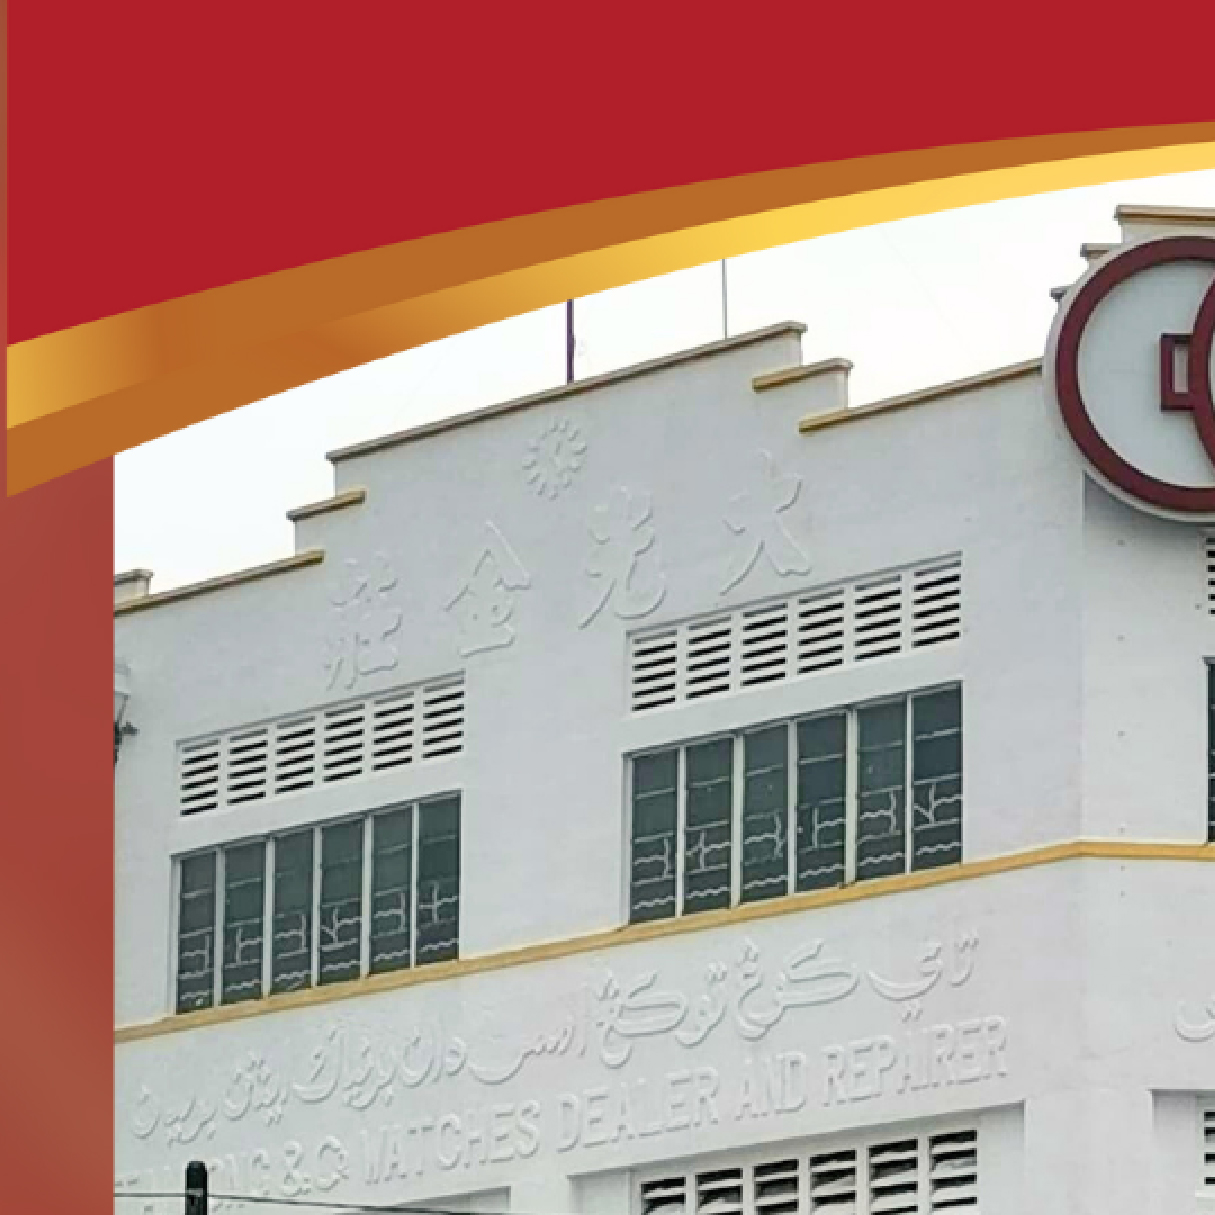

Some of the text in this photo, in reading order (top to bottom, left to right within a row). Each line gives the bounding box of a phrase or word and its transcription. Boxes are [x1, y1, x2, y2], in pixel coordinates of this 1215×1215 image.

[556, 1066, 720, 1153] DEALER
[735, 1049, 808, 1121] AND
[820, 1014, 1009, 1106] REPAIRER
